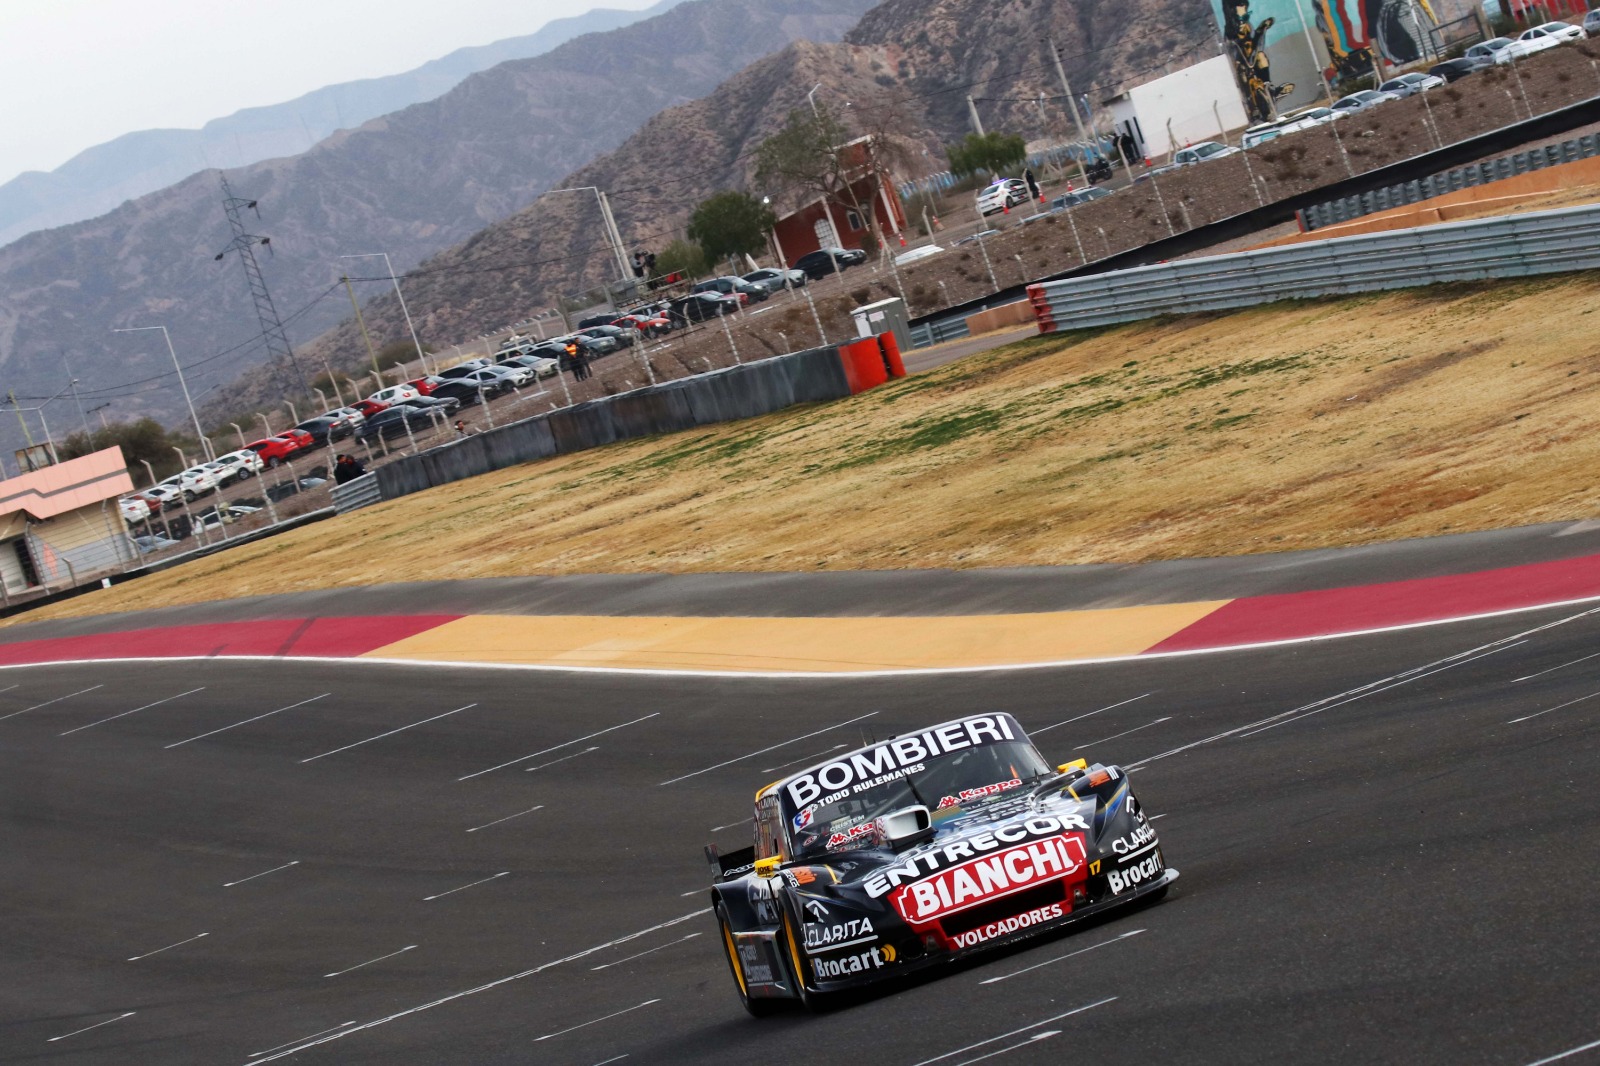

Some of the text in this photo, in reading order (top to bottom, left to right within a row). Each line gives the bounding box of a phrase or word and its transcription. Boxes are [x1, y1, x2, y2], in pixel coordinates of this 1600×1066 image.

[786, 715, 1015, 810] BOMBIERI
[817, 763, 926, 808] TODO RULEMANES
[959, 779, 1023, 800] Kappa
[863, 814, 1090, 899] ENTRECOR
[910, 839, 1075, 918] BIANCHI
[1089, 859, 1101, 876] 17
[807, 917, 874, 947] CLARITA
[953, 903, 1063, 949] VOLCADORES
[815, 946, 885, 978] Brocart
